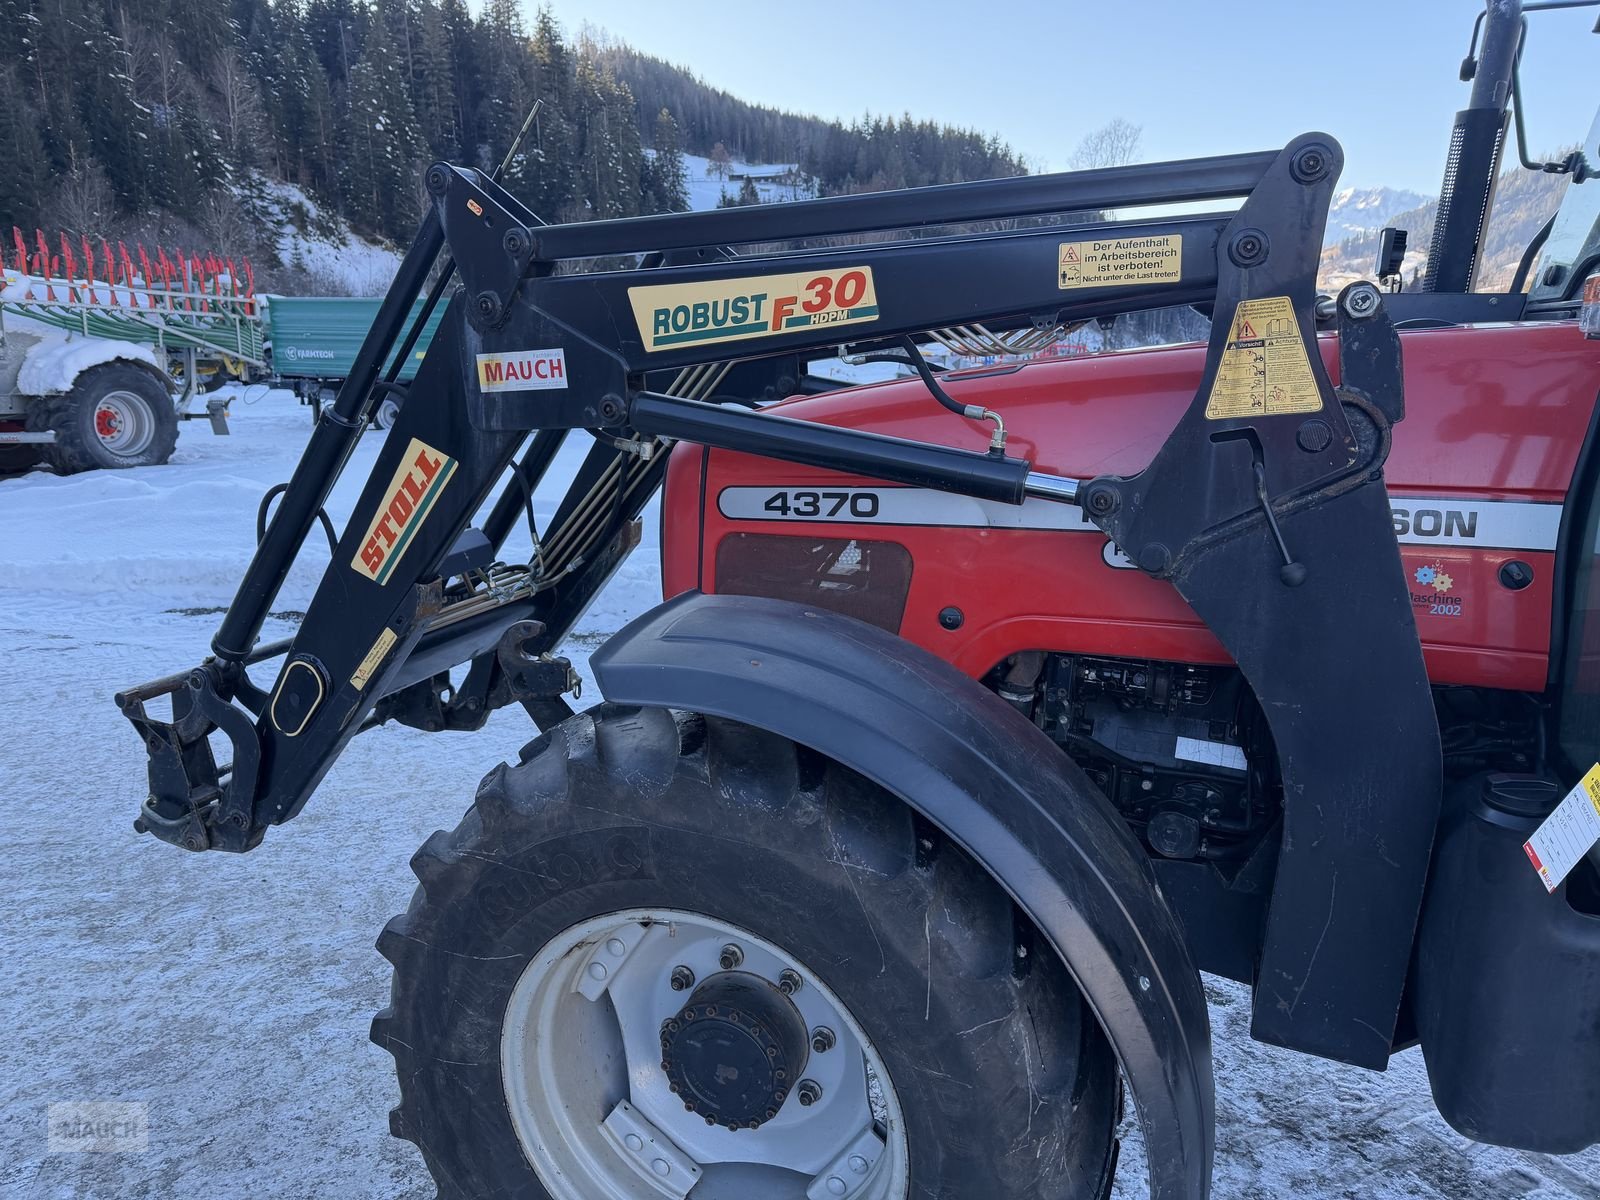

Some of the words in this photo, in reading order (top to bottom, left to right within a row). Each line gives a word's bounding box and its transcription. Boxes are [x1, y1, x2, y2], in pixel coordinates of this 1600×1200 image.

[1093, 242, 1112, 252] Der
[1114, 238, 1170, 251] Aufenthalt
[1084, 253, 1098, 263] im
[1099, 248, 1178, 262] Arbeitsbereich
[1097, 263, 1111, 273] ist
[1113, 259, 1164, 271] verboten!
[1082, 275, 1102, 283] Nicht
[1103, 274, 1123, 282] unter
[1123, 272, 1136, 280] die
[1136, 271, 1154, 279] Last
[1154, 270, 1179, 278] treten!
[653, 293, 768, 336] ROBUST
[772, 295, 798, 331] F
[801, 270, 867, 313] 30
[809, 309, 850, 325] HDPM
[297, 349, 335, 359] FARMTECH
[483, 358, 563, 382] MAUCH
[360, 449, 442, 575] STOLL
[763, 491, 880, 518] 4370
[1429, 603, 1462, 616] 2002
